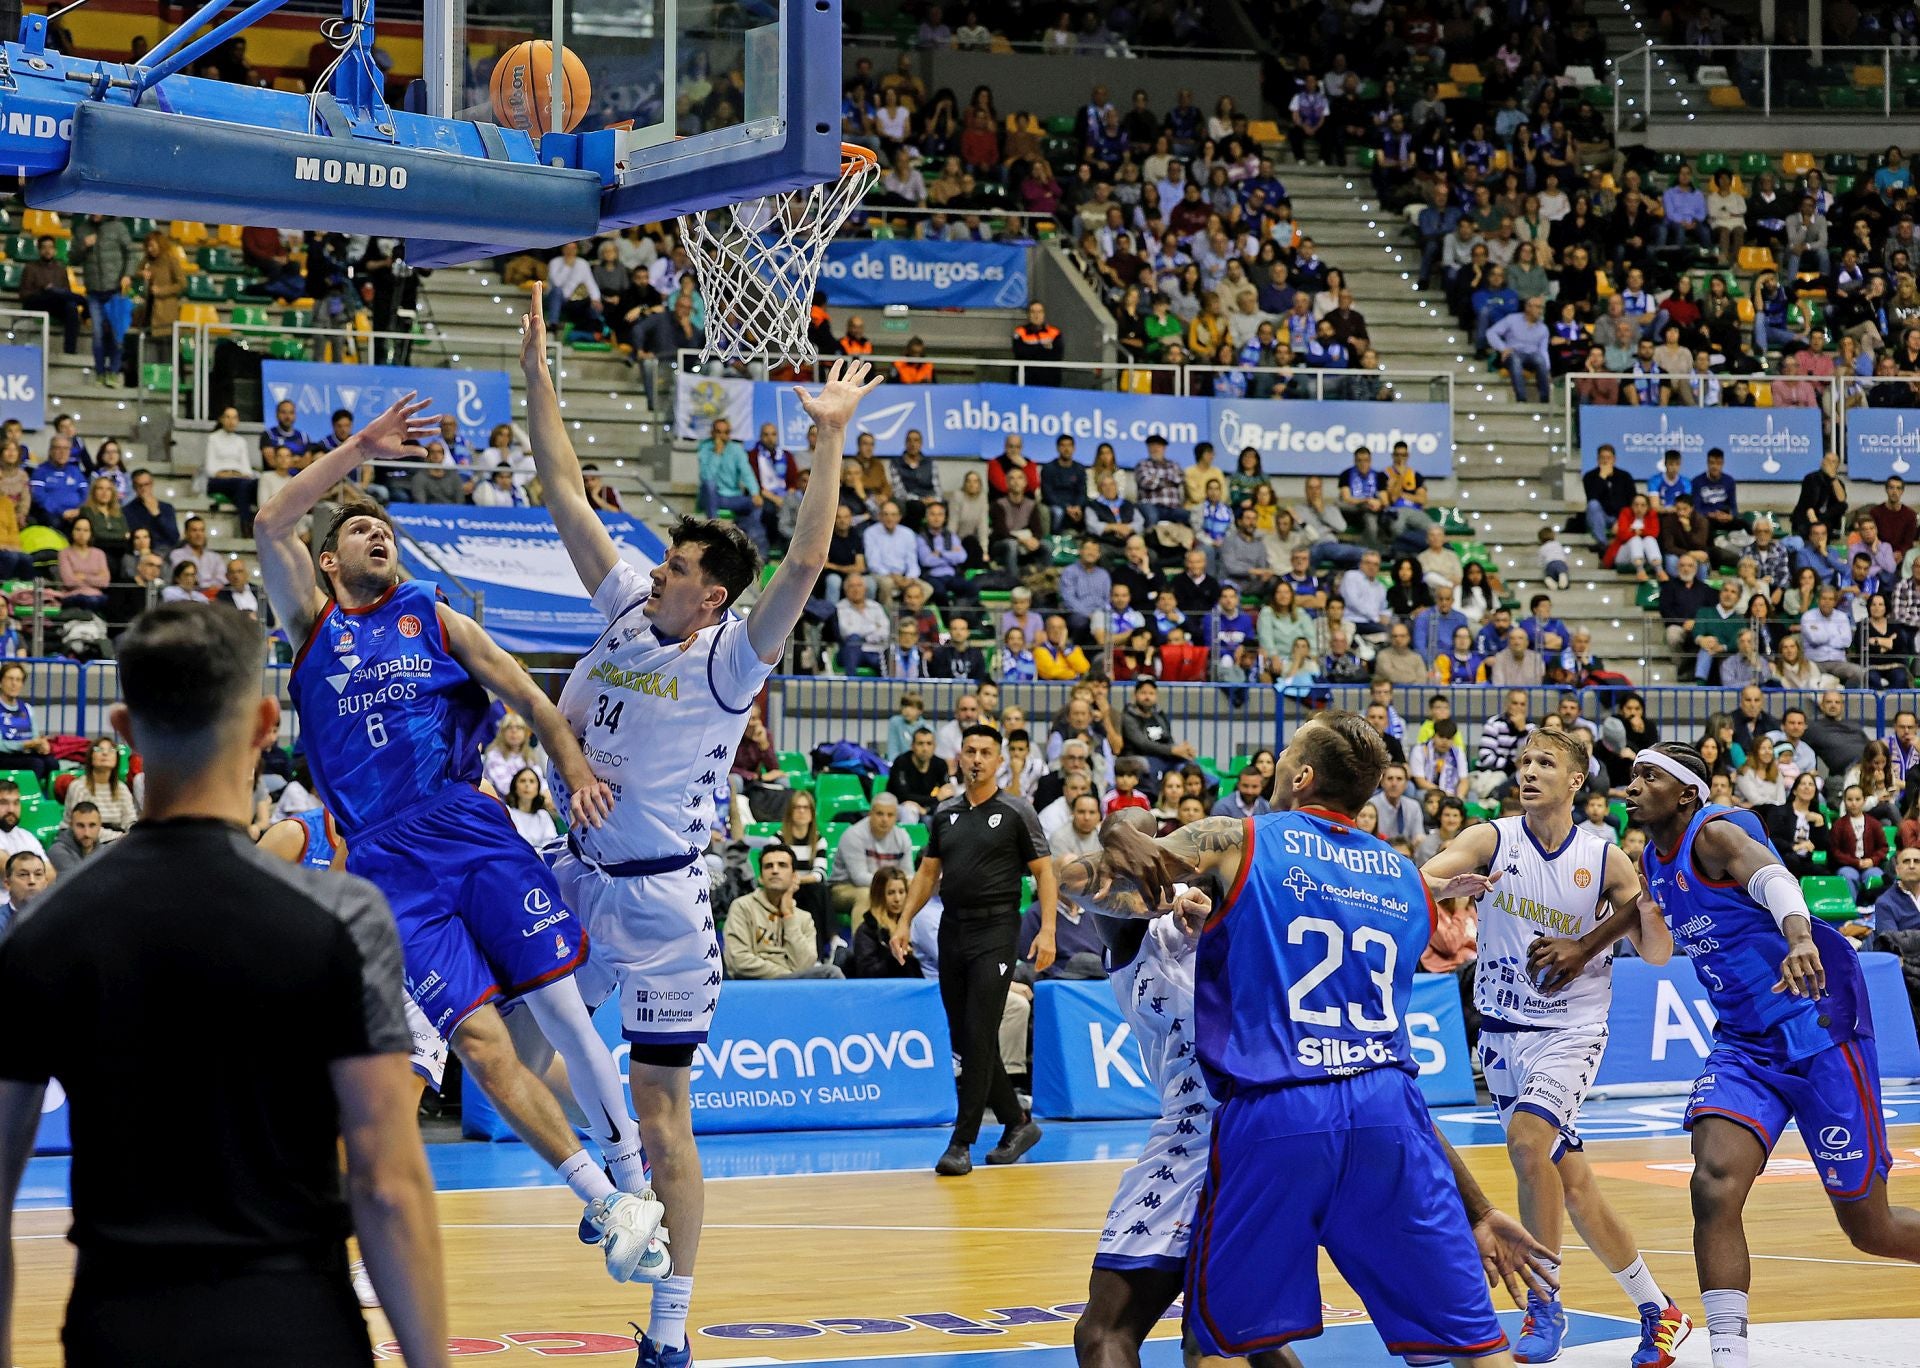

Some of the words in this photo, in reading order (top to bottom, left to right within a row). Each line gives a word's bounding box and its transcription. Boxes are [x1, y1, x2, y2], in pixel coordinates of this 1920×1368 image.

[295, 156, 408, 190] MONDO
[852, 253, 884, 280] de
[890, 254, 1004, 289] Burgos.es
[944, 400, 1199, 444] abbahotels.com
[1240, 422, 1438, 454] BricoCentro
[338, 682, 417, 717] BURGOS
[593, 694, 625, 735] 34
[365, 712, 389, 748] 6
[1283, 829, 1402, 879] STUMBRIS
[1320, 882, 1379, 904] recoletas
[1381, 897, 1409, 914] salud
[1492, 890, 1583, 936] ALIMERKA
[522, 909, 570, 938] LEXUS
[1287, 915, 1399, 1032] 23
[1702, 964, 1724, 992] 5
[649, 991, 690, 1001] OVIEDO
[658, 1008, 693, 1018] Asturias
[689, 1090, 797, 1110] SEGURIDAD
[797, 1088, 812, 1105] Y
[818, 1083, 881, 1103] SALUD
[1535, 1087, 1564, 1106] Asturias
[1814, 1148, 1864, 1161] LEXUS
